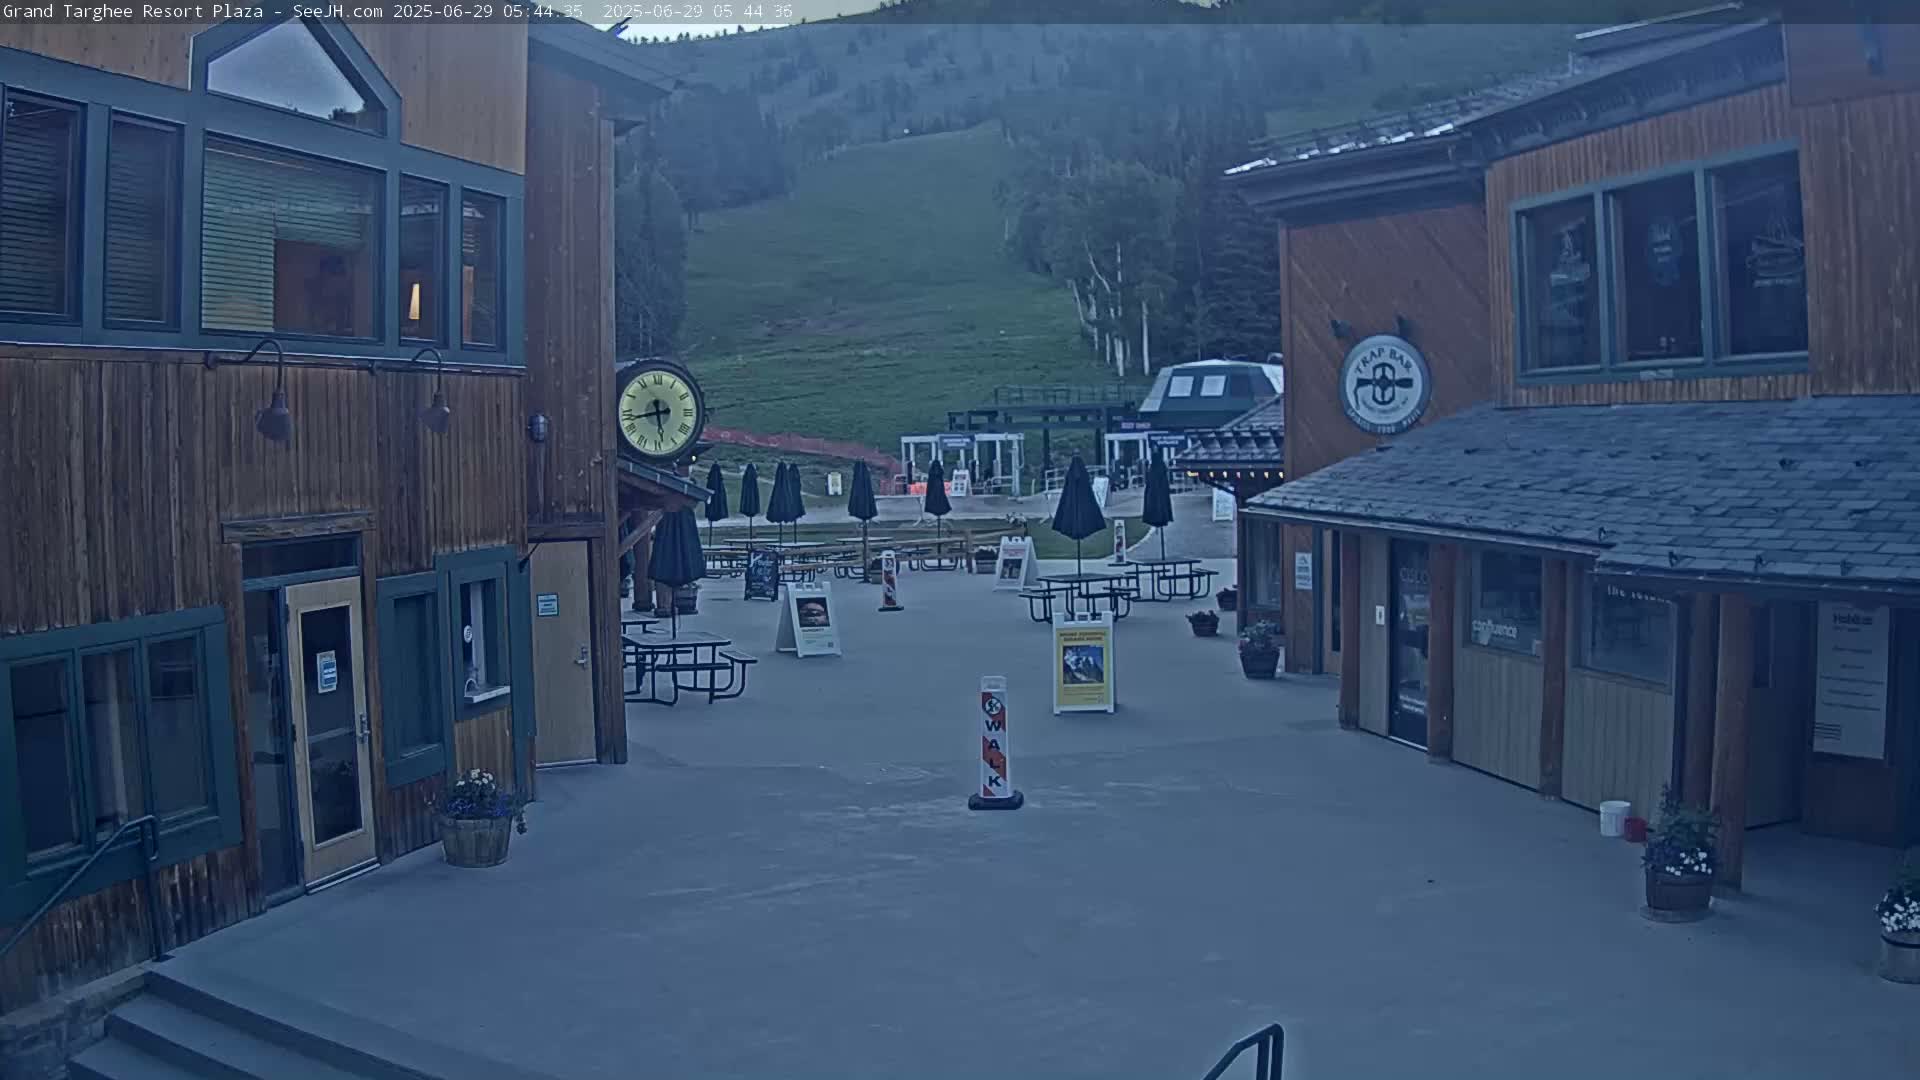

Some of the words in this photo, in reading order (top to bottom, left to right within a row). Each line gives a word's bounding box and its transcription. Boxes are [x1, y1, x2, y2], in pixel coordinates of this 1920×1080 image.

[1355, 347, 1385, 374] TRAP
[1389, 348, 1413, 373] BAR
[683, 408, 693, 417] III
[985, 719, 1002, 788] WALK
